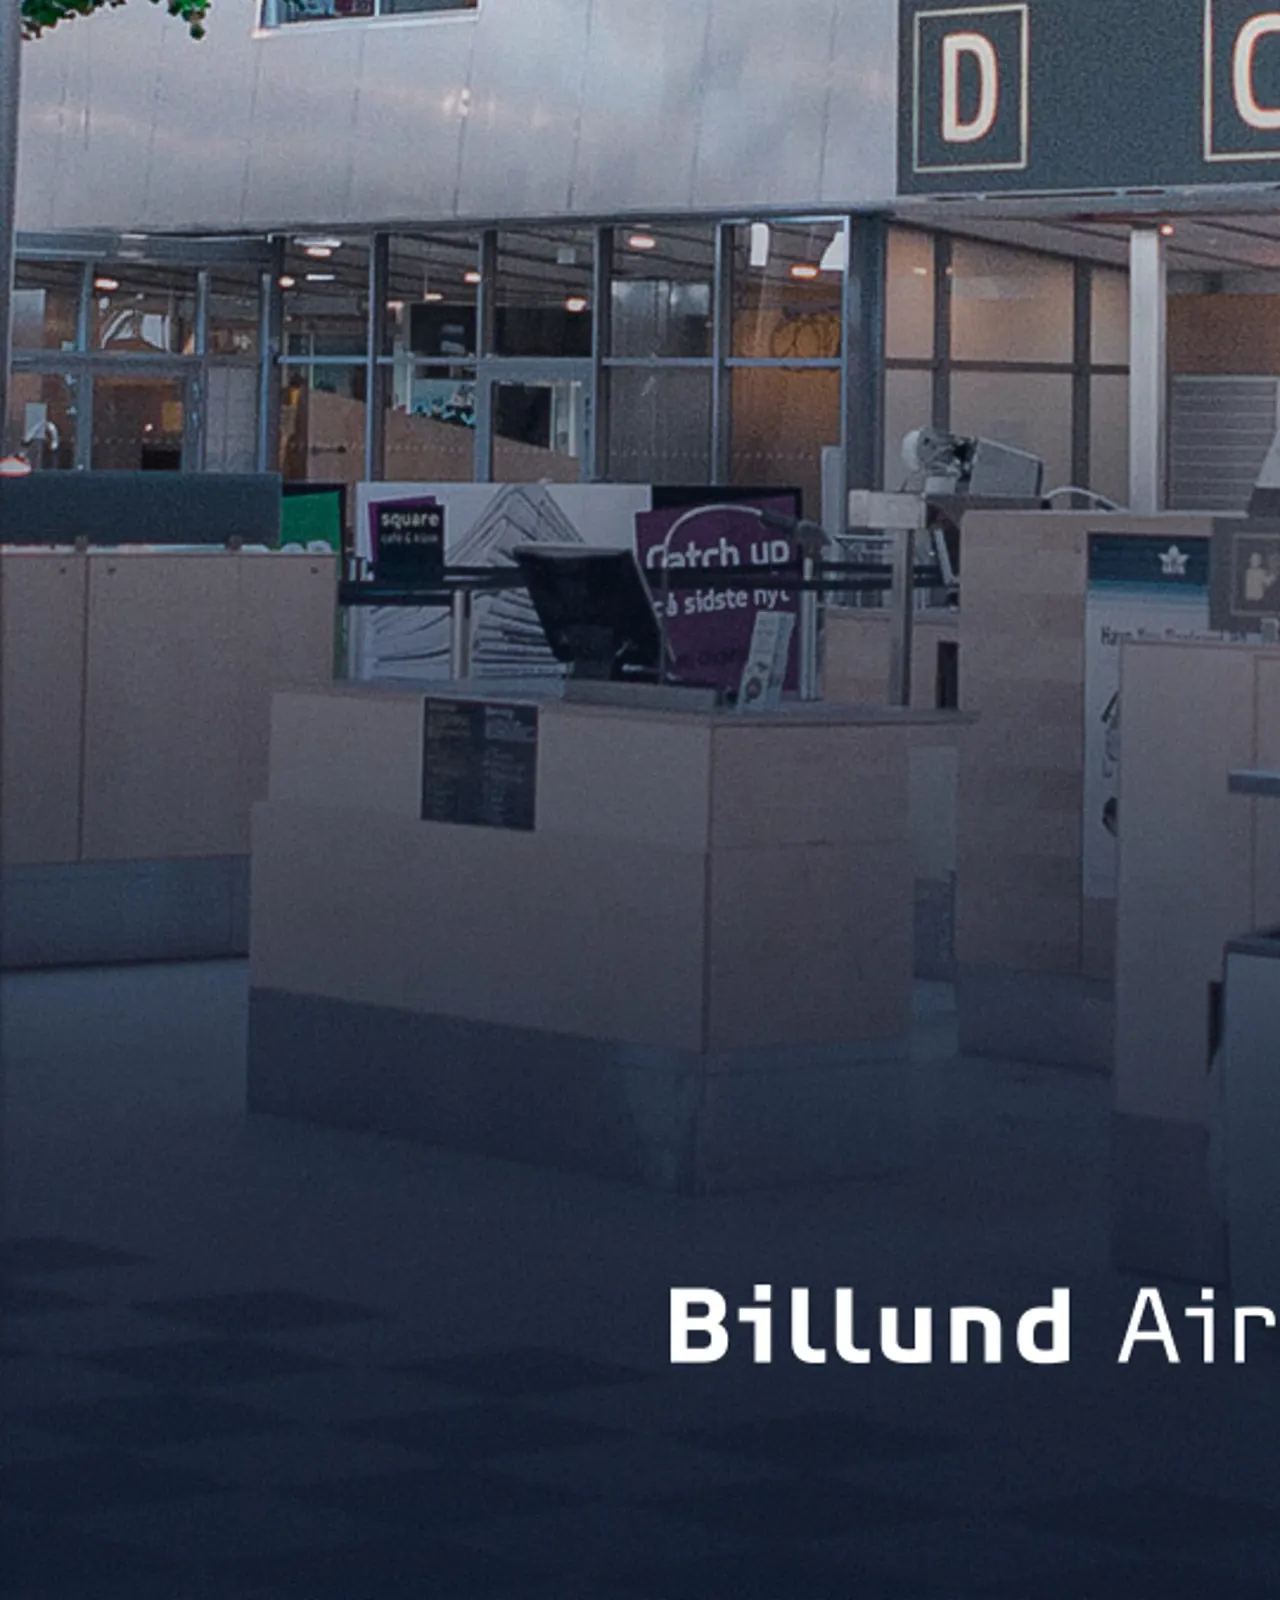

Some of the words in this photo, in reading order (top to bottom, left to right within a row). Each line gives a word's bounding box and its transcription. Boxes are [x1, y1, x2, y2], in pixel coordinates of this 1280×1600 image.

[941, 32, 998, 143] D
[381, 510, 440, 528] square
[684, 587, 748, 615] sidste
